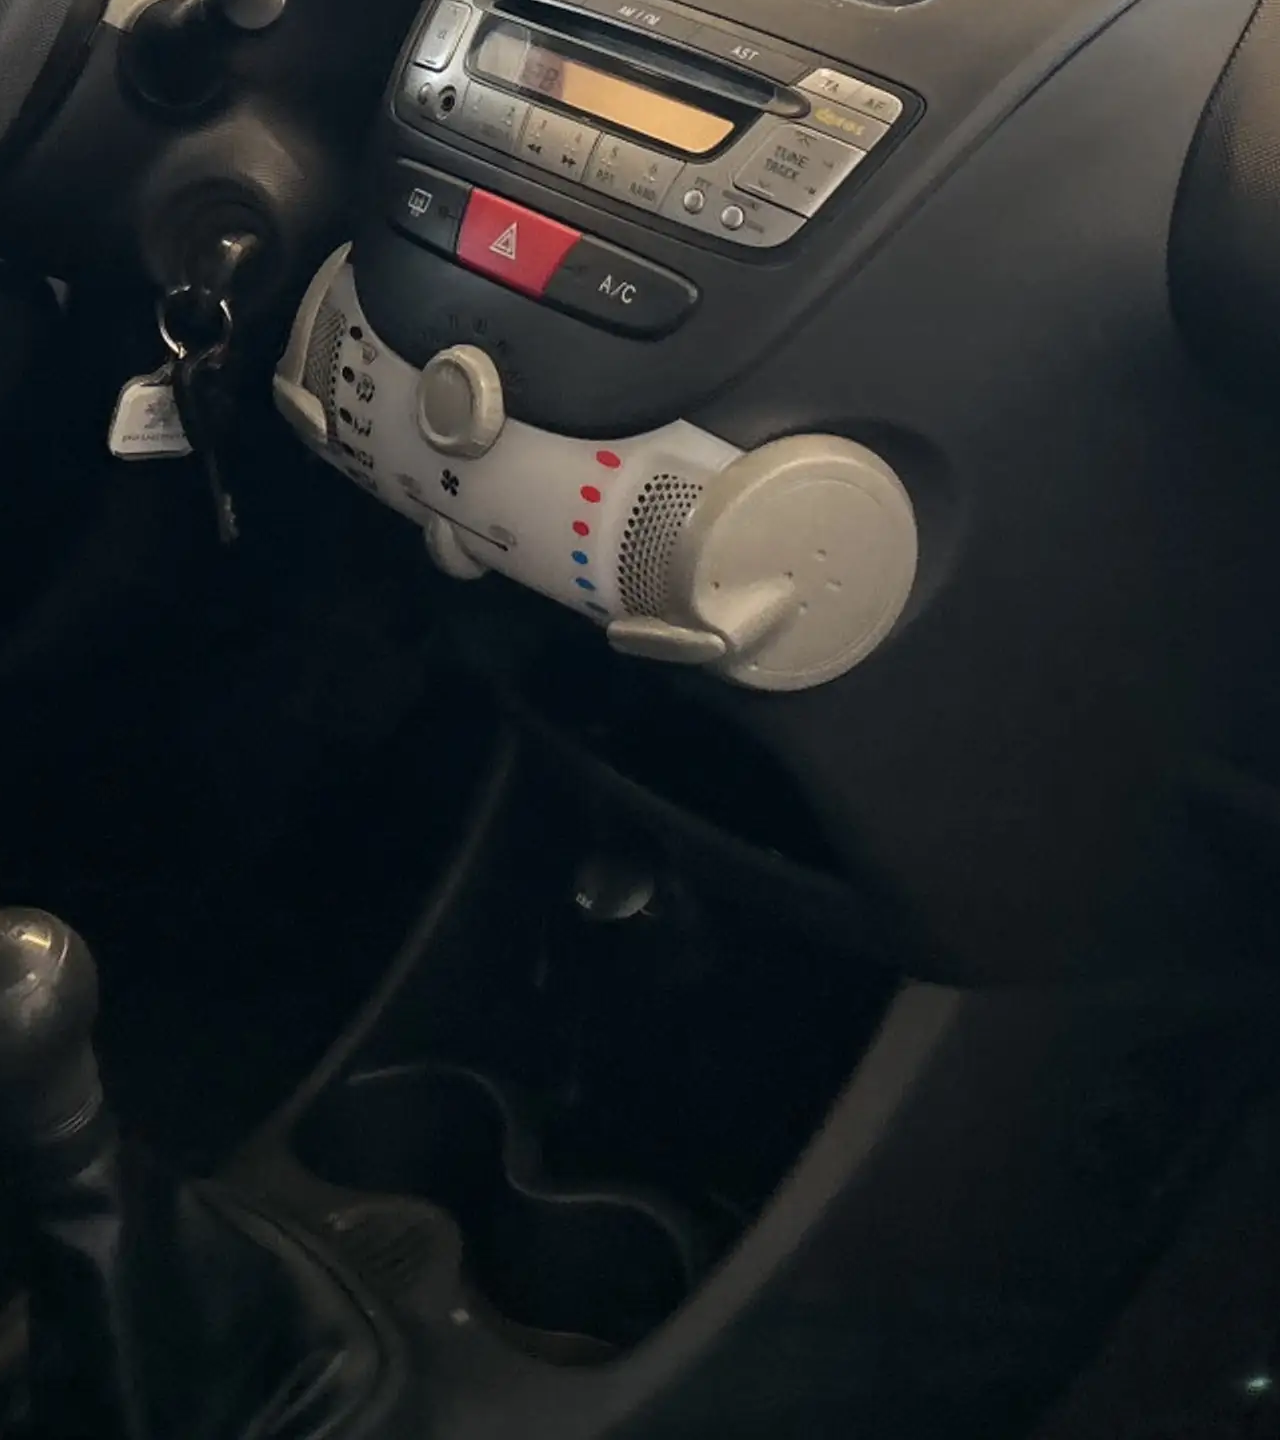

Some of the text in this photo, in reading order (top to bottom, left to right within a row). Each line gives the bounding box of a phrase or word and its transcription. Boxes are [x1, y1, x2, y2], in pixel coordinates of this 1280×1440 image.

[730, 43, 760, 61] AST
[773, 144, 810, 169] TUNE
[598, 273, 637, 305] A/C
